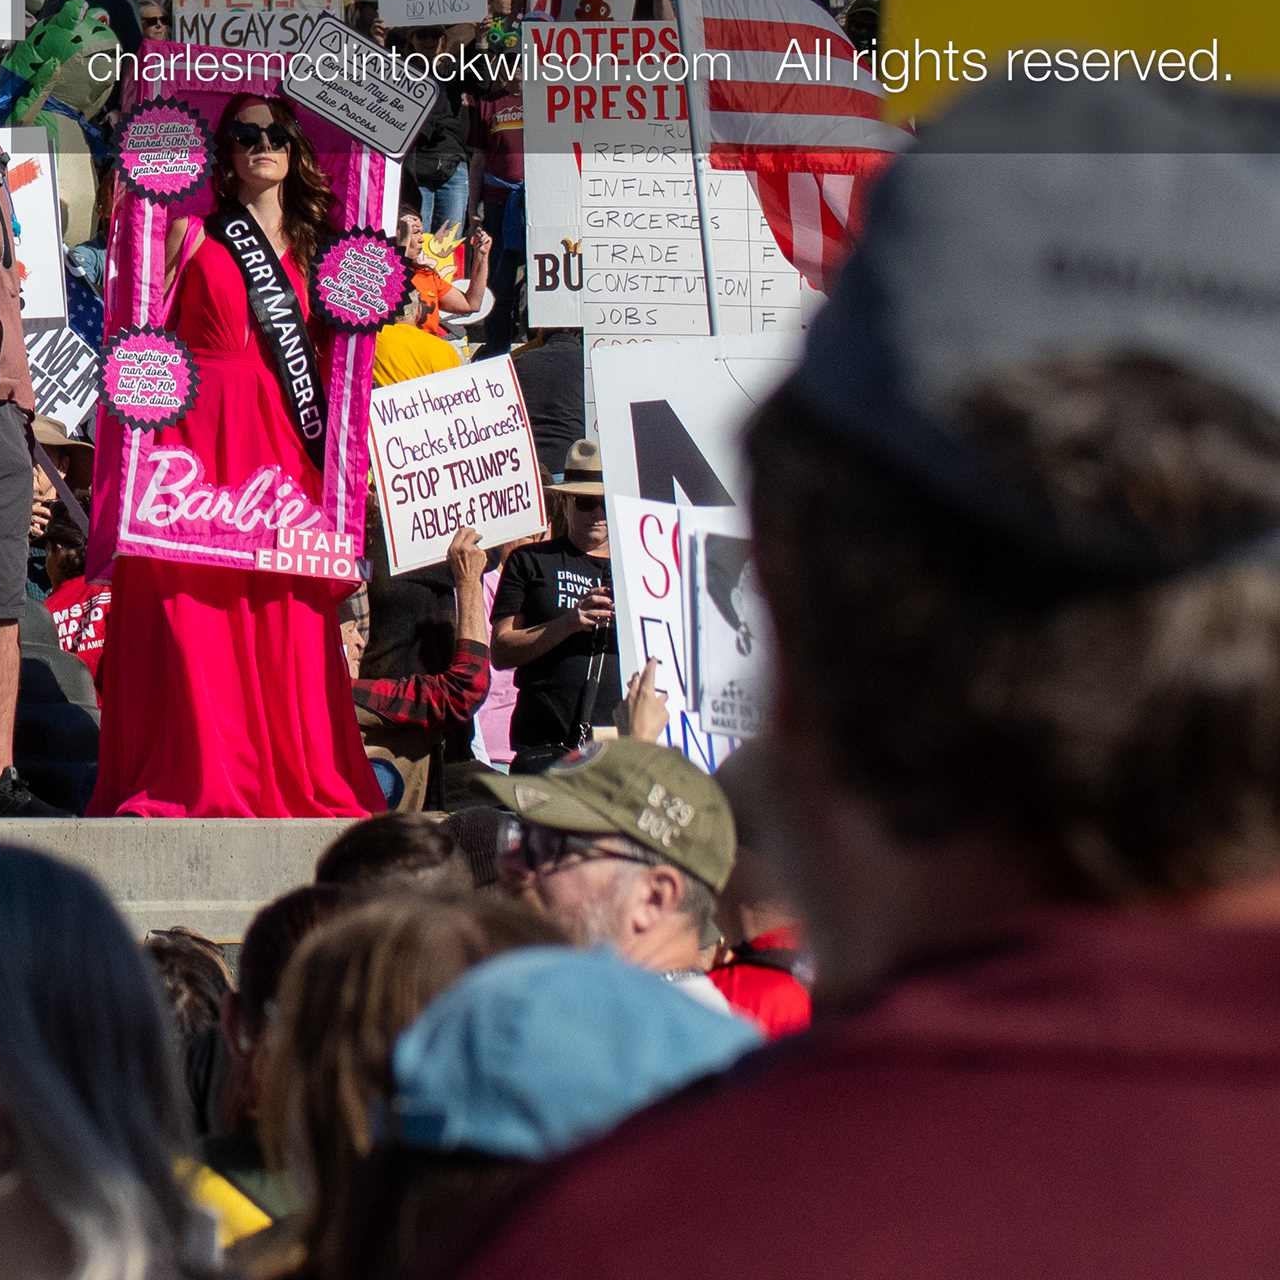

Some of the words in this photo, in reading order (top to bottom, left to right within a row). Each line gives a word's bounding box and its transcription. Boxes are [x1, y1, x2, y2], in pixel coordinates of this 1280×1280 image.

[180, 13, 218, 46] MY
[220, 13, 271, 47] GAY
[531, 27, 678, 67] VOTERS
[365, 83, 388, 104] May
[390, 97, 404, 112] Be
[316, 90, 336, 107] Due
[340, 104, 377, 133] Process
[367, 102, 408, 131] Without
[131, 126, 155, 135] 2025
[128, 138, 162, 148] Ranked
[165, 137, 187, 147] 50th
[141, 151, 177, 164] equality
[133, 166, 160, 178] years
[162, 163, 198, 174] running
[365, 244, 385, 257] Sold
[590, 244, 679, 264] TRADE
[339, 272, 381, 295] Affordable
[328, 293, 368, 317] Autonomy
[360, 294, 387, 312] Bodily
[597, 307, 657, 325] JOBS
[225, 220, 323, 440] GERRYMANDERED
[116, 350, 169, 365] Everything
[121, 367, 143, 375] man
[119, 379, 135, 389] but
[131, 394, 147, 404] the
[150, 395, 180, 405] dollar
[373, 396, 419, 426] What
[419, 378, 480, 415] Happened
[486, 379, 504, 398] to
[387, 429, 448, 469] Checks
[391, 467, 439, 505] STOP
[444, 447, 520, 490] TRUMP'S
[136, 451, 321, 532] Barbie
[412, 502, 464, 541] ABUSE
[479, 481, 531, 522] POWER!
[278, 529, 352, 555] UTAH
[258, 550, 372, 581] EDITION
[558, 570, 592, 587] DRINK
